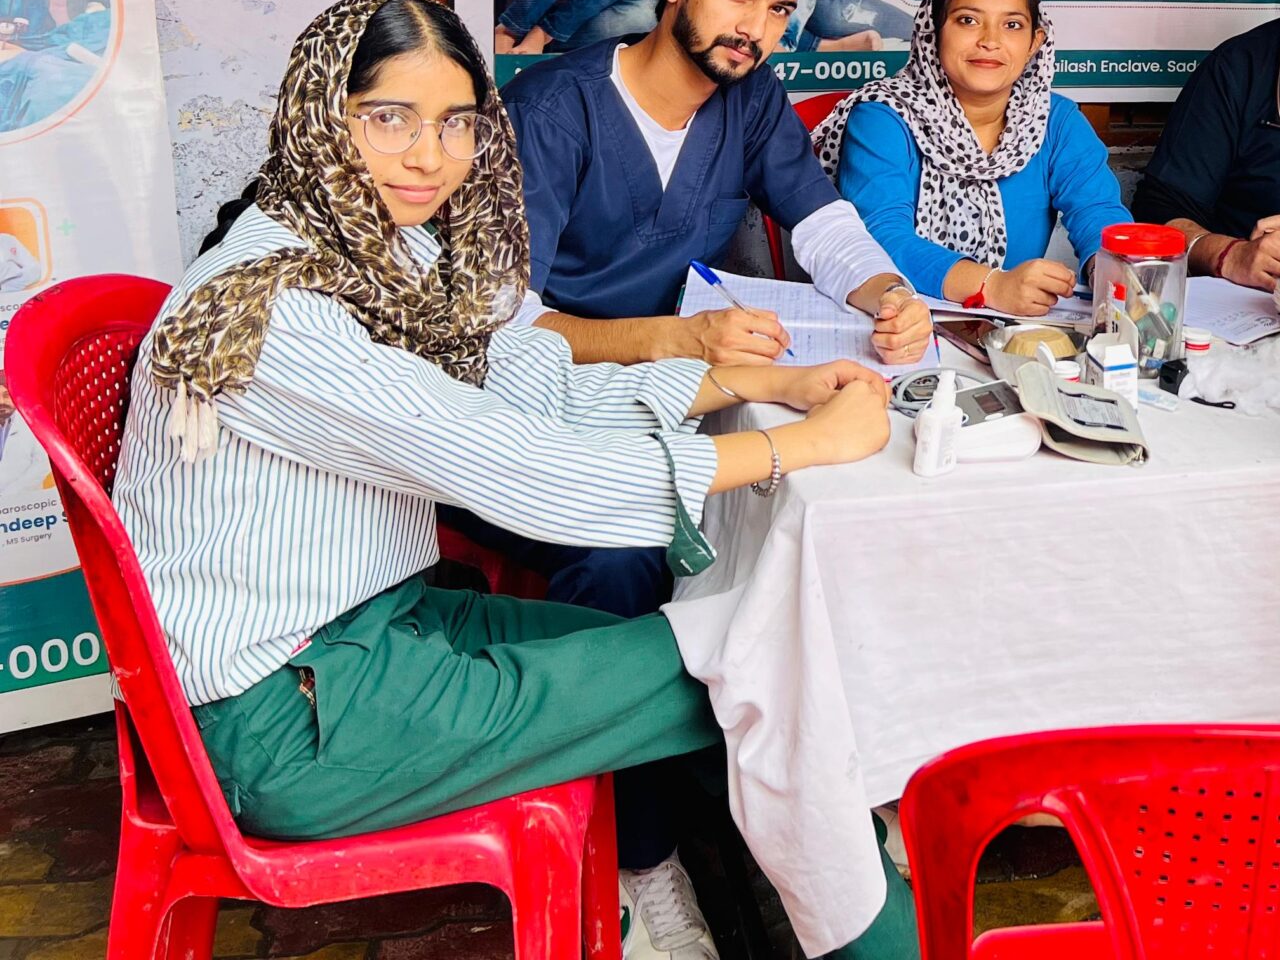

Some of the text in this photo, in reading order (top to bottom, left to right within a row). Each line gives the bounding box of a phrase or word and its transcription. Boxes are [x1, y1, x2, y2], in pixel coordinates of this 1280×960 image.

[774, 60, 887, 80] 47-00016
[1053, 60, 1198, 73] ailash Enclave. Sad
[0, 499, 57, 516] aroscopic
[21, 532, 52, 542] Surgery
